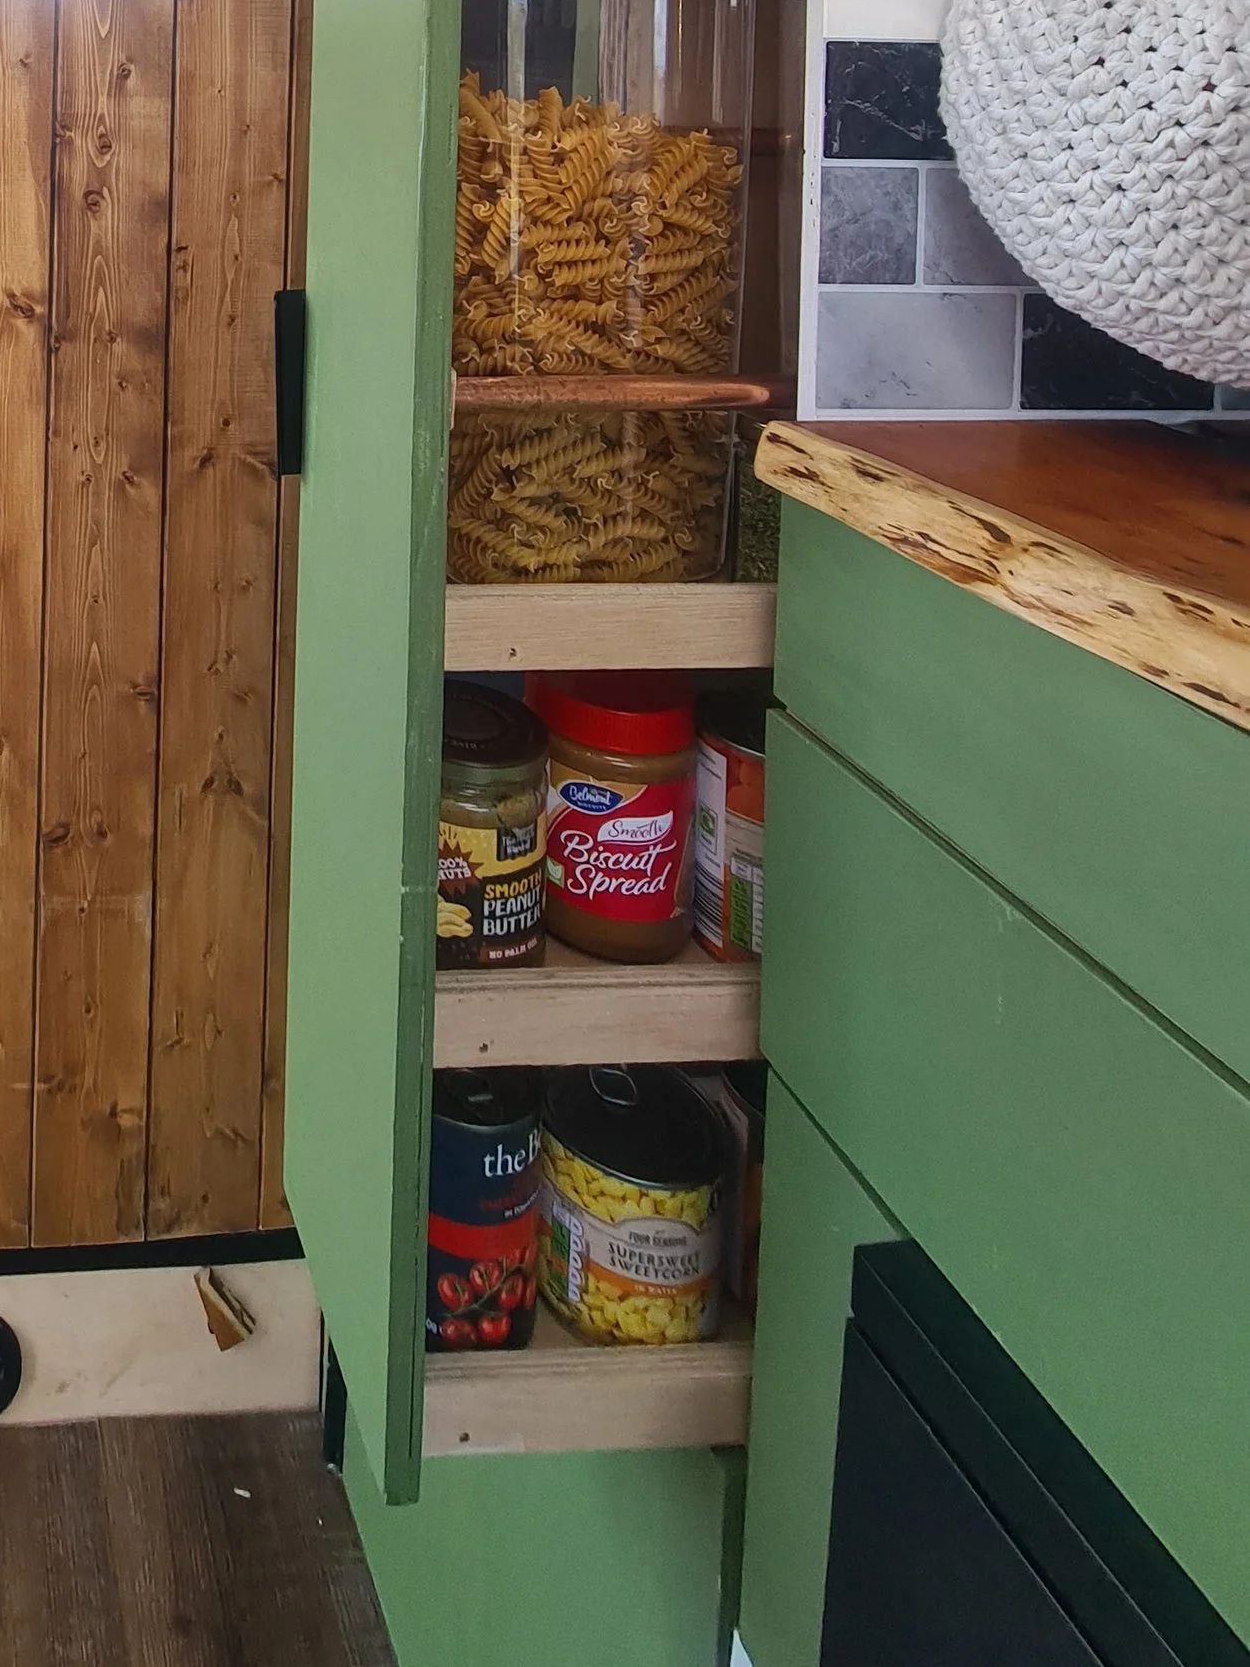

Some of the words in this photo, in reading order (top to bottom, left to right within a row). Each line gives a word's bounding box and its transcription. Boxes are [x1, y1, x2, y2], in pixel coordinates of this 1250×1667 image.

[569, 785, 611, 806] Belmont
[438, 856, 468, 869] 00%
[560, 830, 678, 877] Biscuit
[484, 871, 542, 900] SMOOTH
[567, 863, 673, 901] Spread
[483, 884, 541, 917] PEANUT
[483, 903, 541, 936] BUTTER
[489, 950, 503, 960] NO
[504, 944, 526, 958] PALM
[608, 1241, 701, 1268] SUPERSWEET
[609, 1255, 700, 1280] SWEETCORN
